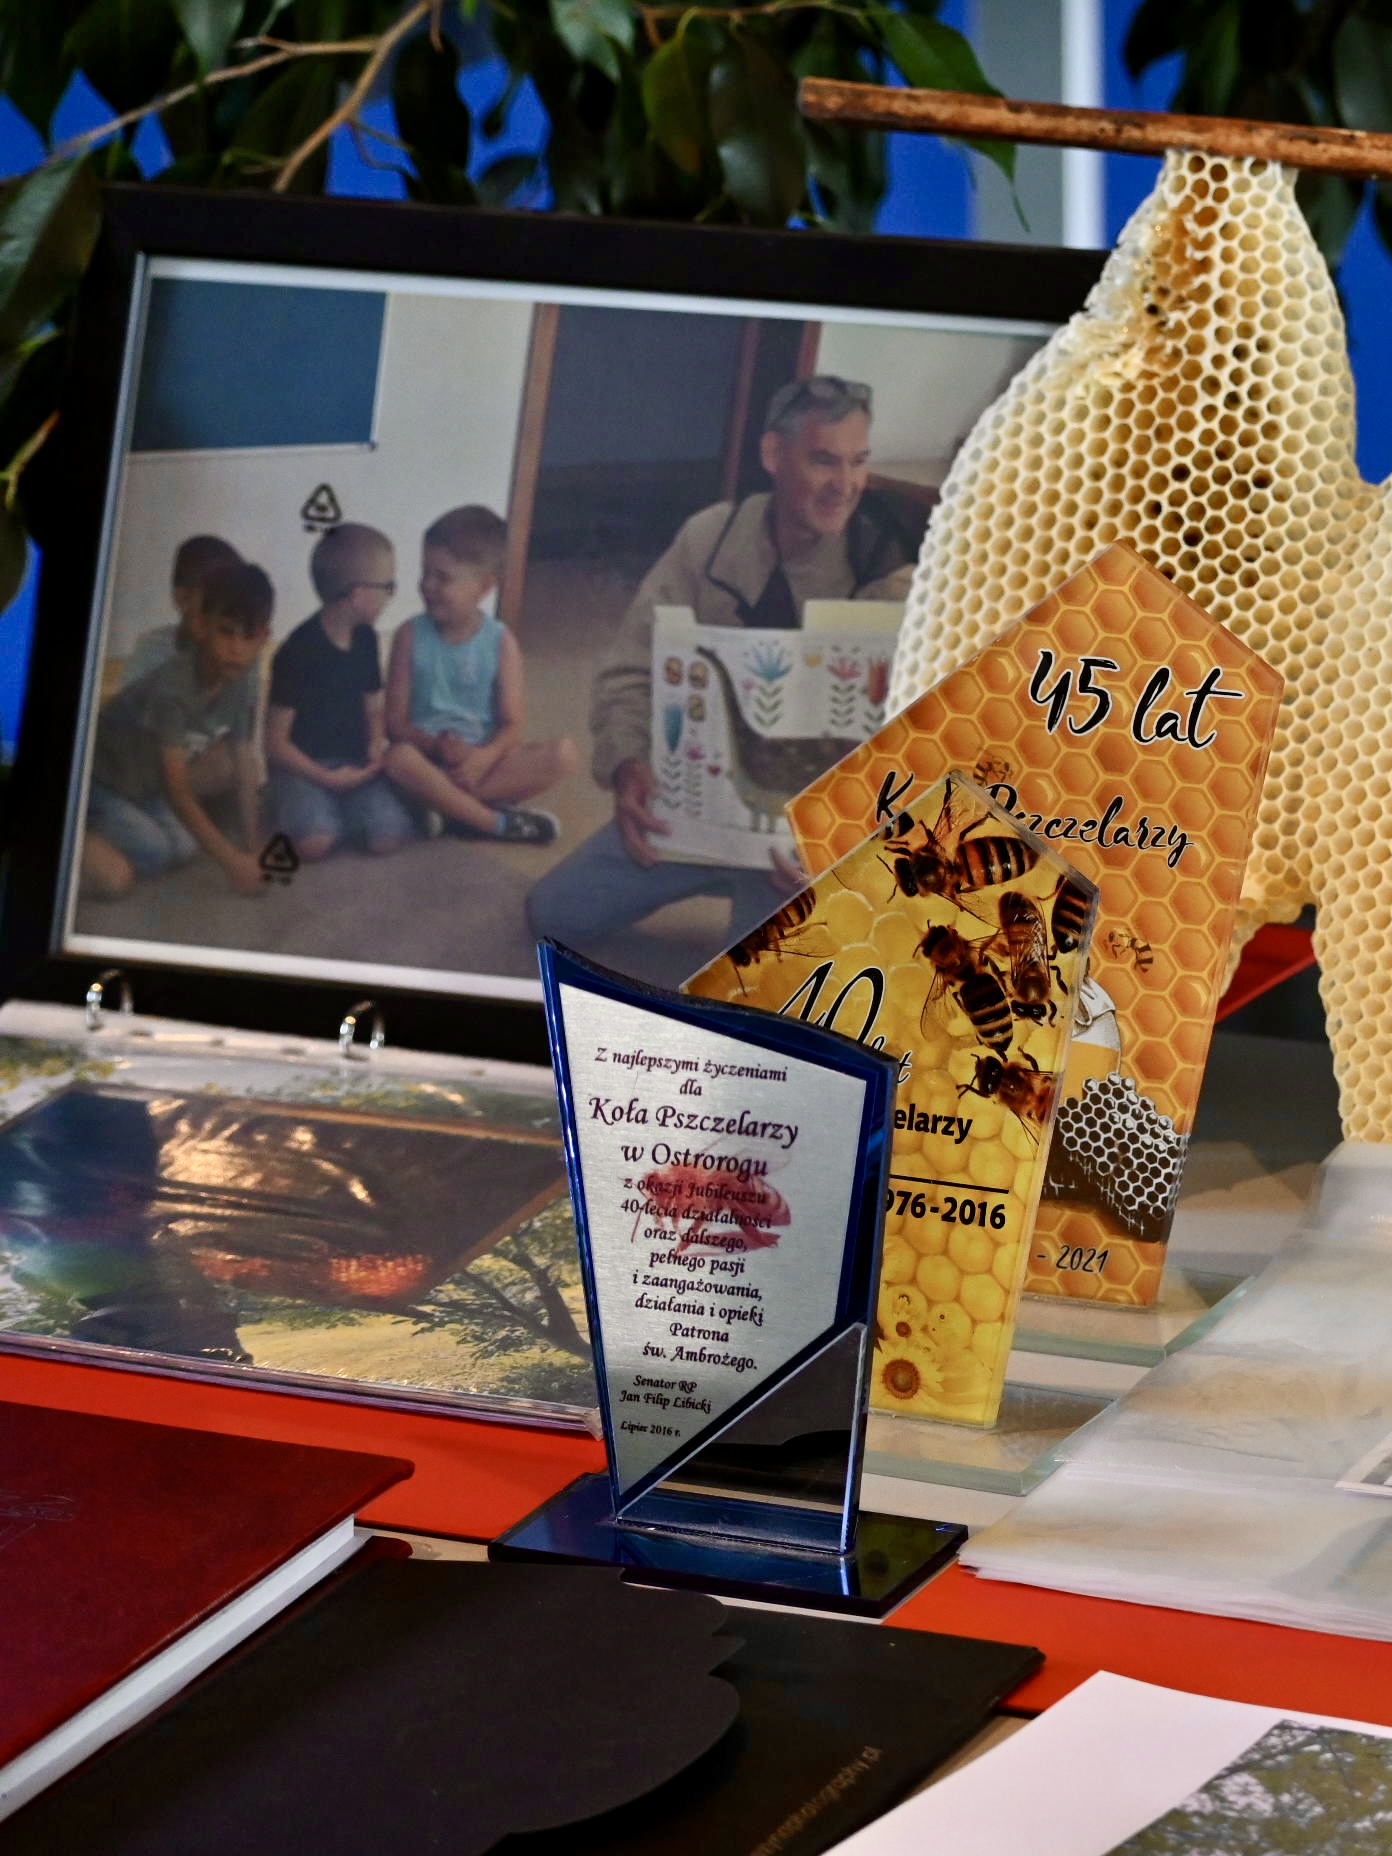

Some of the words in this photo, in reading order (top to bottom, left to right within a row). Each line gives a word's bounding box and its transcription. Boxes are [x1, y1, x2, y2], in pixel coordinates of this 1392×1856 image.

[1029, 649, 1120, 735] 45
[1131, 667, 1245, 749] lat
[595, 1048, 608, 1062] Z
[612, 1050, 700, 1074] najlepszymi
[703, 1059, 788, 1082] życzeniami
[679, 1079, 703, 1096] dla
[589, 1097, 648, 1126] Koła
[655, 1105, 799, 1149] Pszczelarzy
[892, 1103, 973, 1144] elarzy
[620, 1145, 644, 1162] w
[652, 1142, 768, 1183] Ostrorogu
[623, 1178, 633, 1190] z
[637, 1179, 683, 1198] okazji
[687, 1182, 769, 1204] Jubileuszu
[621, 1199, 679, 1218] 40-lecia
[682, 1206, 772, 1229] działalności
[884, 1188, 1006, 1230] 976-2016
[644, 1228, 677, 1242] oraz
[681, 1228, 747, 1253] dalszego,
[650, 1250, 706, 1272] pełnego
[709, 1258, 747, 1277] pasji
[1056, 1244, 1110, 1273] 2021
[632, 1269, 639, 1284] i
[642, 1274, 763, 1301] zaangażowania,
[635, 1293, 705, 1316] działania
[709, 1303, 716, 1317] i
[719, 1305, 765, 1327] opieki
[669, 1322, 730, 1343] Patrona
[642, 1342, 667, 1358] św.
[670, 1346, 758, 1373] Ambrożego.
[633, 1375, 677, 1389] Senator
[679, 1381, 697, 1394] RP
[619, 1390, 641, 1402] Jan
[643, 1393, 670, 1410] Filip
[673, 1397, 712, 1414] Libicki
[621, 1421, 648, 1433] Lipiec
[650, 1424, 673, 1436] 2016
